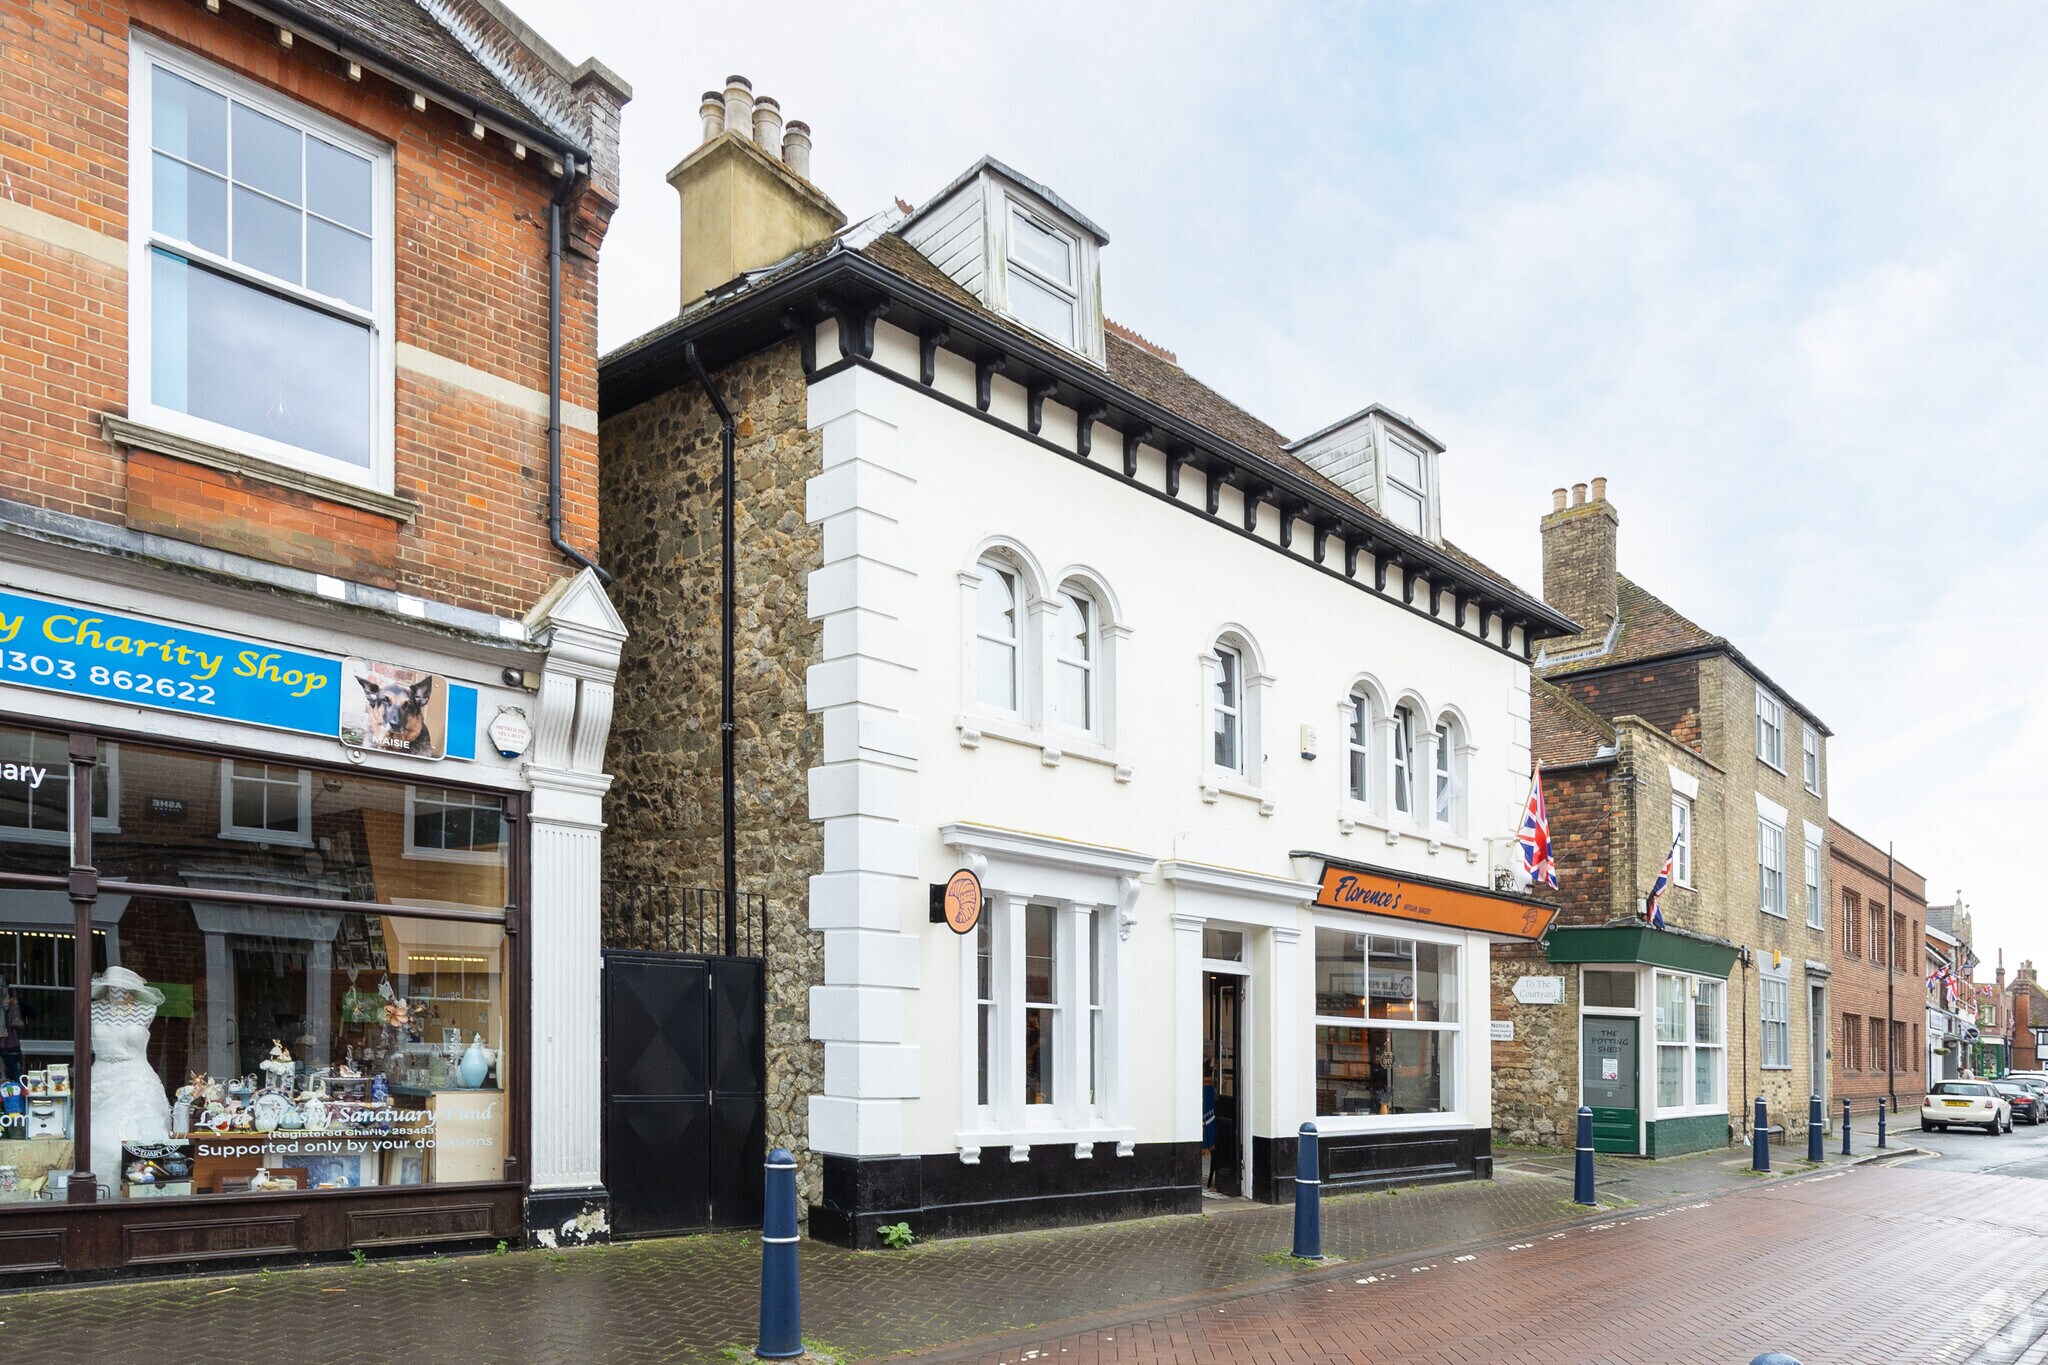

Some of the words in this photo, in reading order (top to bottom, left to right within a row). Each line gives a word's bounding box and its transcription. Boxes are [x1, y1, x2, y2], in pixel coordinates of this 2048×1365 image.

[42, 615, 223, 680] Charity
[233, 650, 327, 697] Shop
[89, 665, 215, 705] 862622
[372, 735, 410, 749] MAISIE
[0, 762, 47, 789] ary
[1334, 876, 1401, 910] Florence's
[1520, 990, 1556, 998] Courtyard
[1525, 980, 1535, 988] To
[1537, 980, 1551, 988] The
[1591, 1037, 1628, 1046] POTTING
[338, 1107, 437, 1128] Sanctuary
[443, 1101, 496, 1121] Fund
[268, 1129, 342, 1141] (Registered
[345, 1128, 389, 1138] Charity
[198, 1140, 299, 1158] Supported
[304, 1140, 343, 1154] only
[347, 1139, 368, 1153] by
[372, 1139, 411, 1152] your
[415, 1137, 493, 1150] donations
